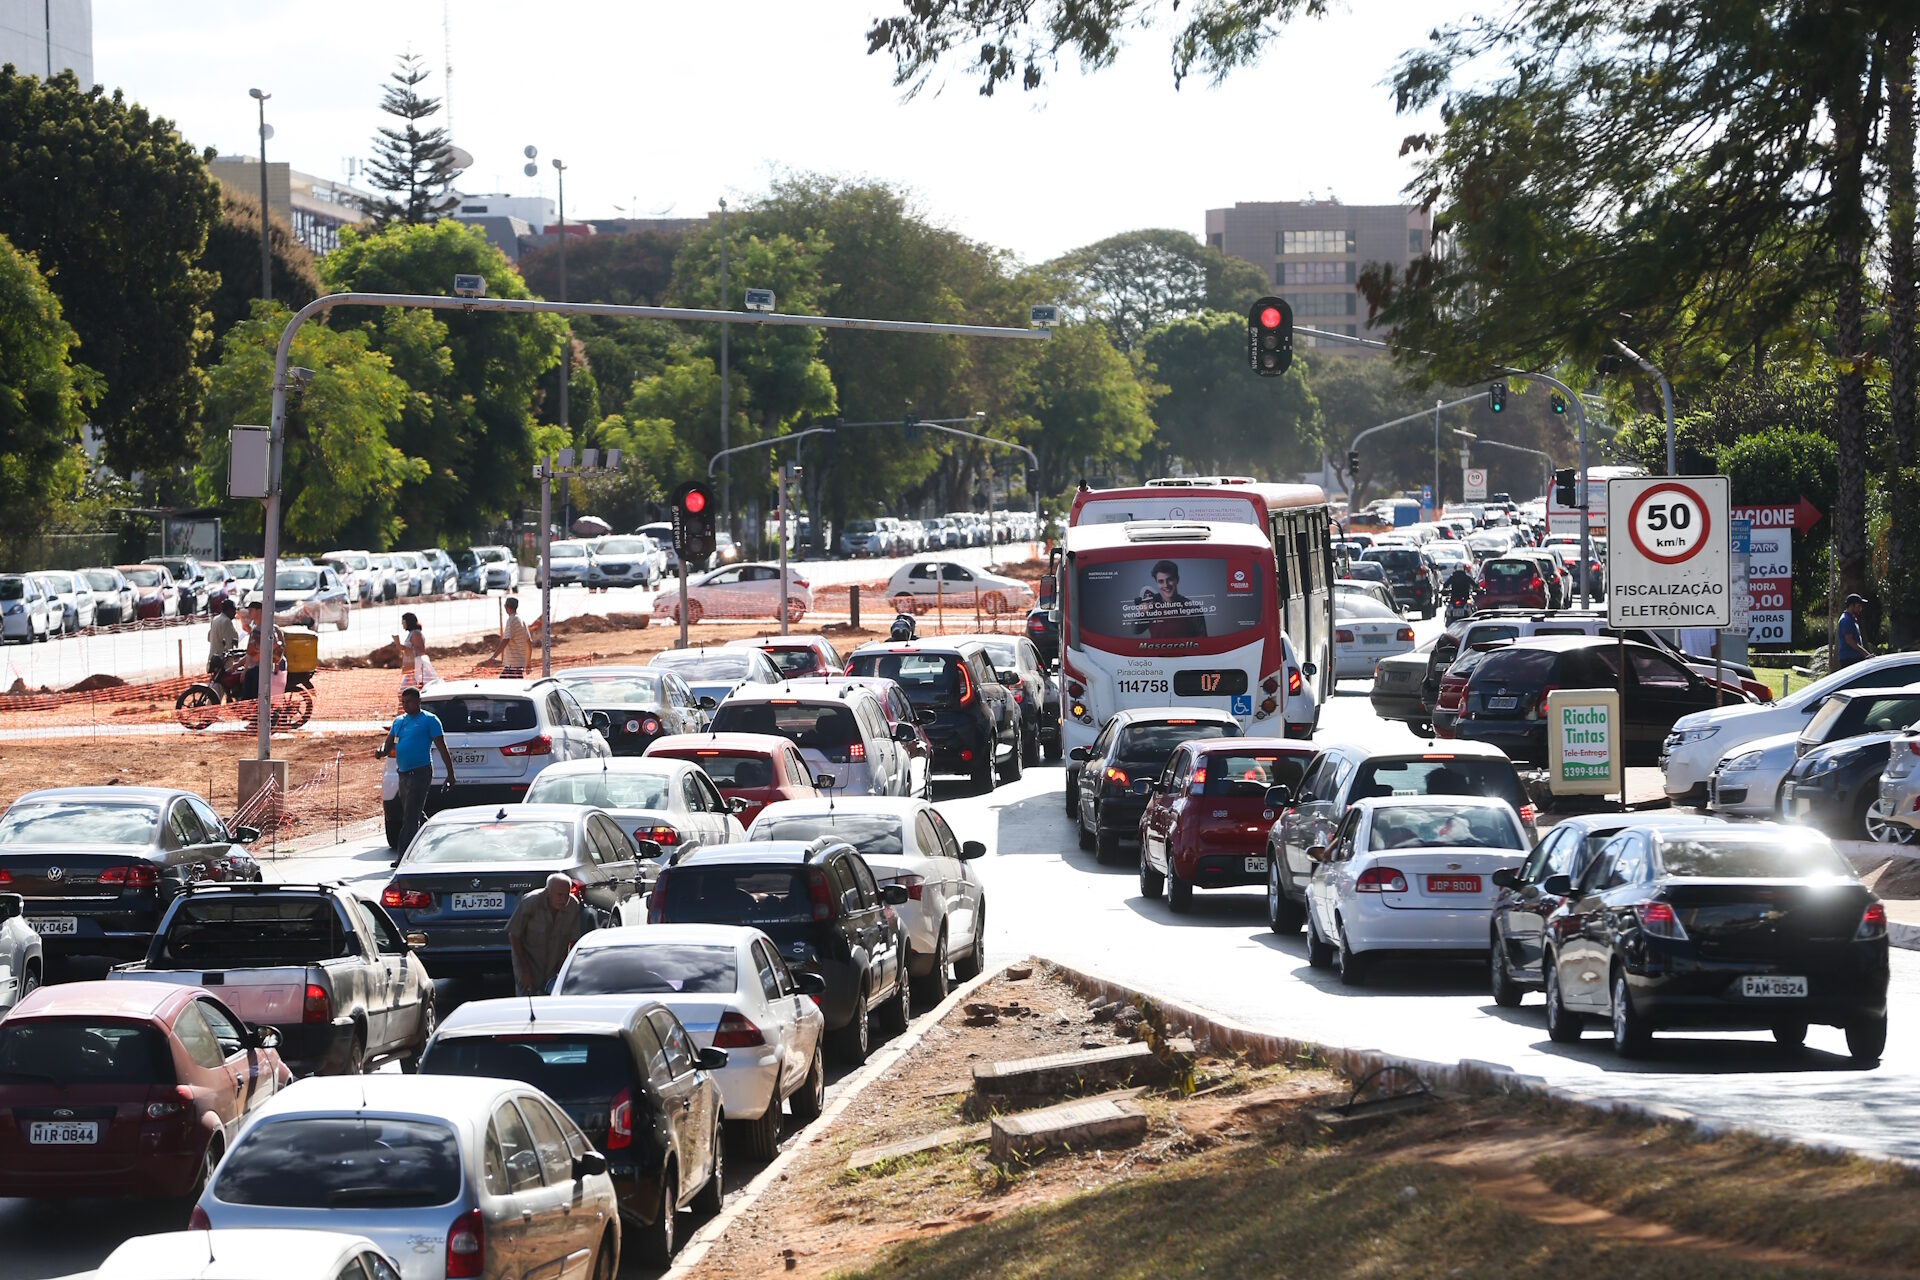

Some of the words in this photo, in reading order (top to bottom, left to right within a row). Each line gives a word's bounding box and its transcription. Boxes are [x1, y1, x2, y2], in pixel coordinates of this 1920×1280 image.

[1647, 503, 1691, 531] 50
[1656, 537, 1686, 548] km/h
[1615, 581, 1723, 598] FISCALIZAÇÃO
[1749, 583, 1777, 591] HORA
[1122, 604, 1147, 612] Graças
[1154, 601, 1183, 609] Cultura,
[1621, 602, 1716, 617] ELETRÔNICA
[1122, 610, 1145, 618] vendo
[1145, 609, 1162, 617] tudo
[1179, 607, 1208, 615] legenda
[1752, 614, 1785, 623] HORAS
[1138, 641, 1200, 649] Mascarello
[1127, 660, 1153, 668] Viação
[1117, 680, 1169, 693] 114758
[1201, 673, 1221, 692] 07
[1563, 707, 1606, 725] Riacho
[1565, 728, 1605, 744] Tintas
[1564, 766, 1609, 777] 3399-8444
[1248, 862, 1264, 871] PWC
[1746, 983, 1804, 995] PAM-0924
